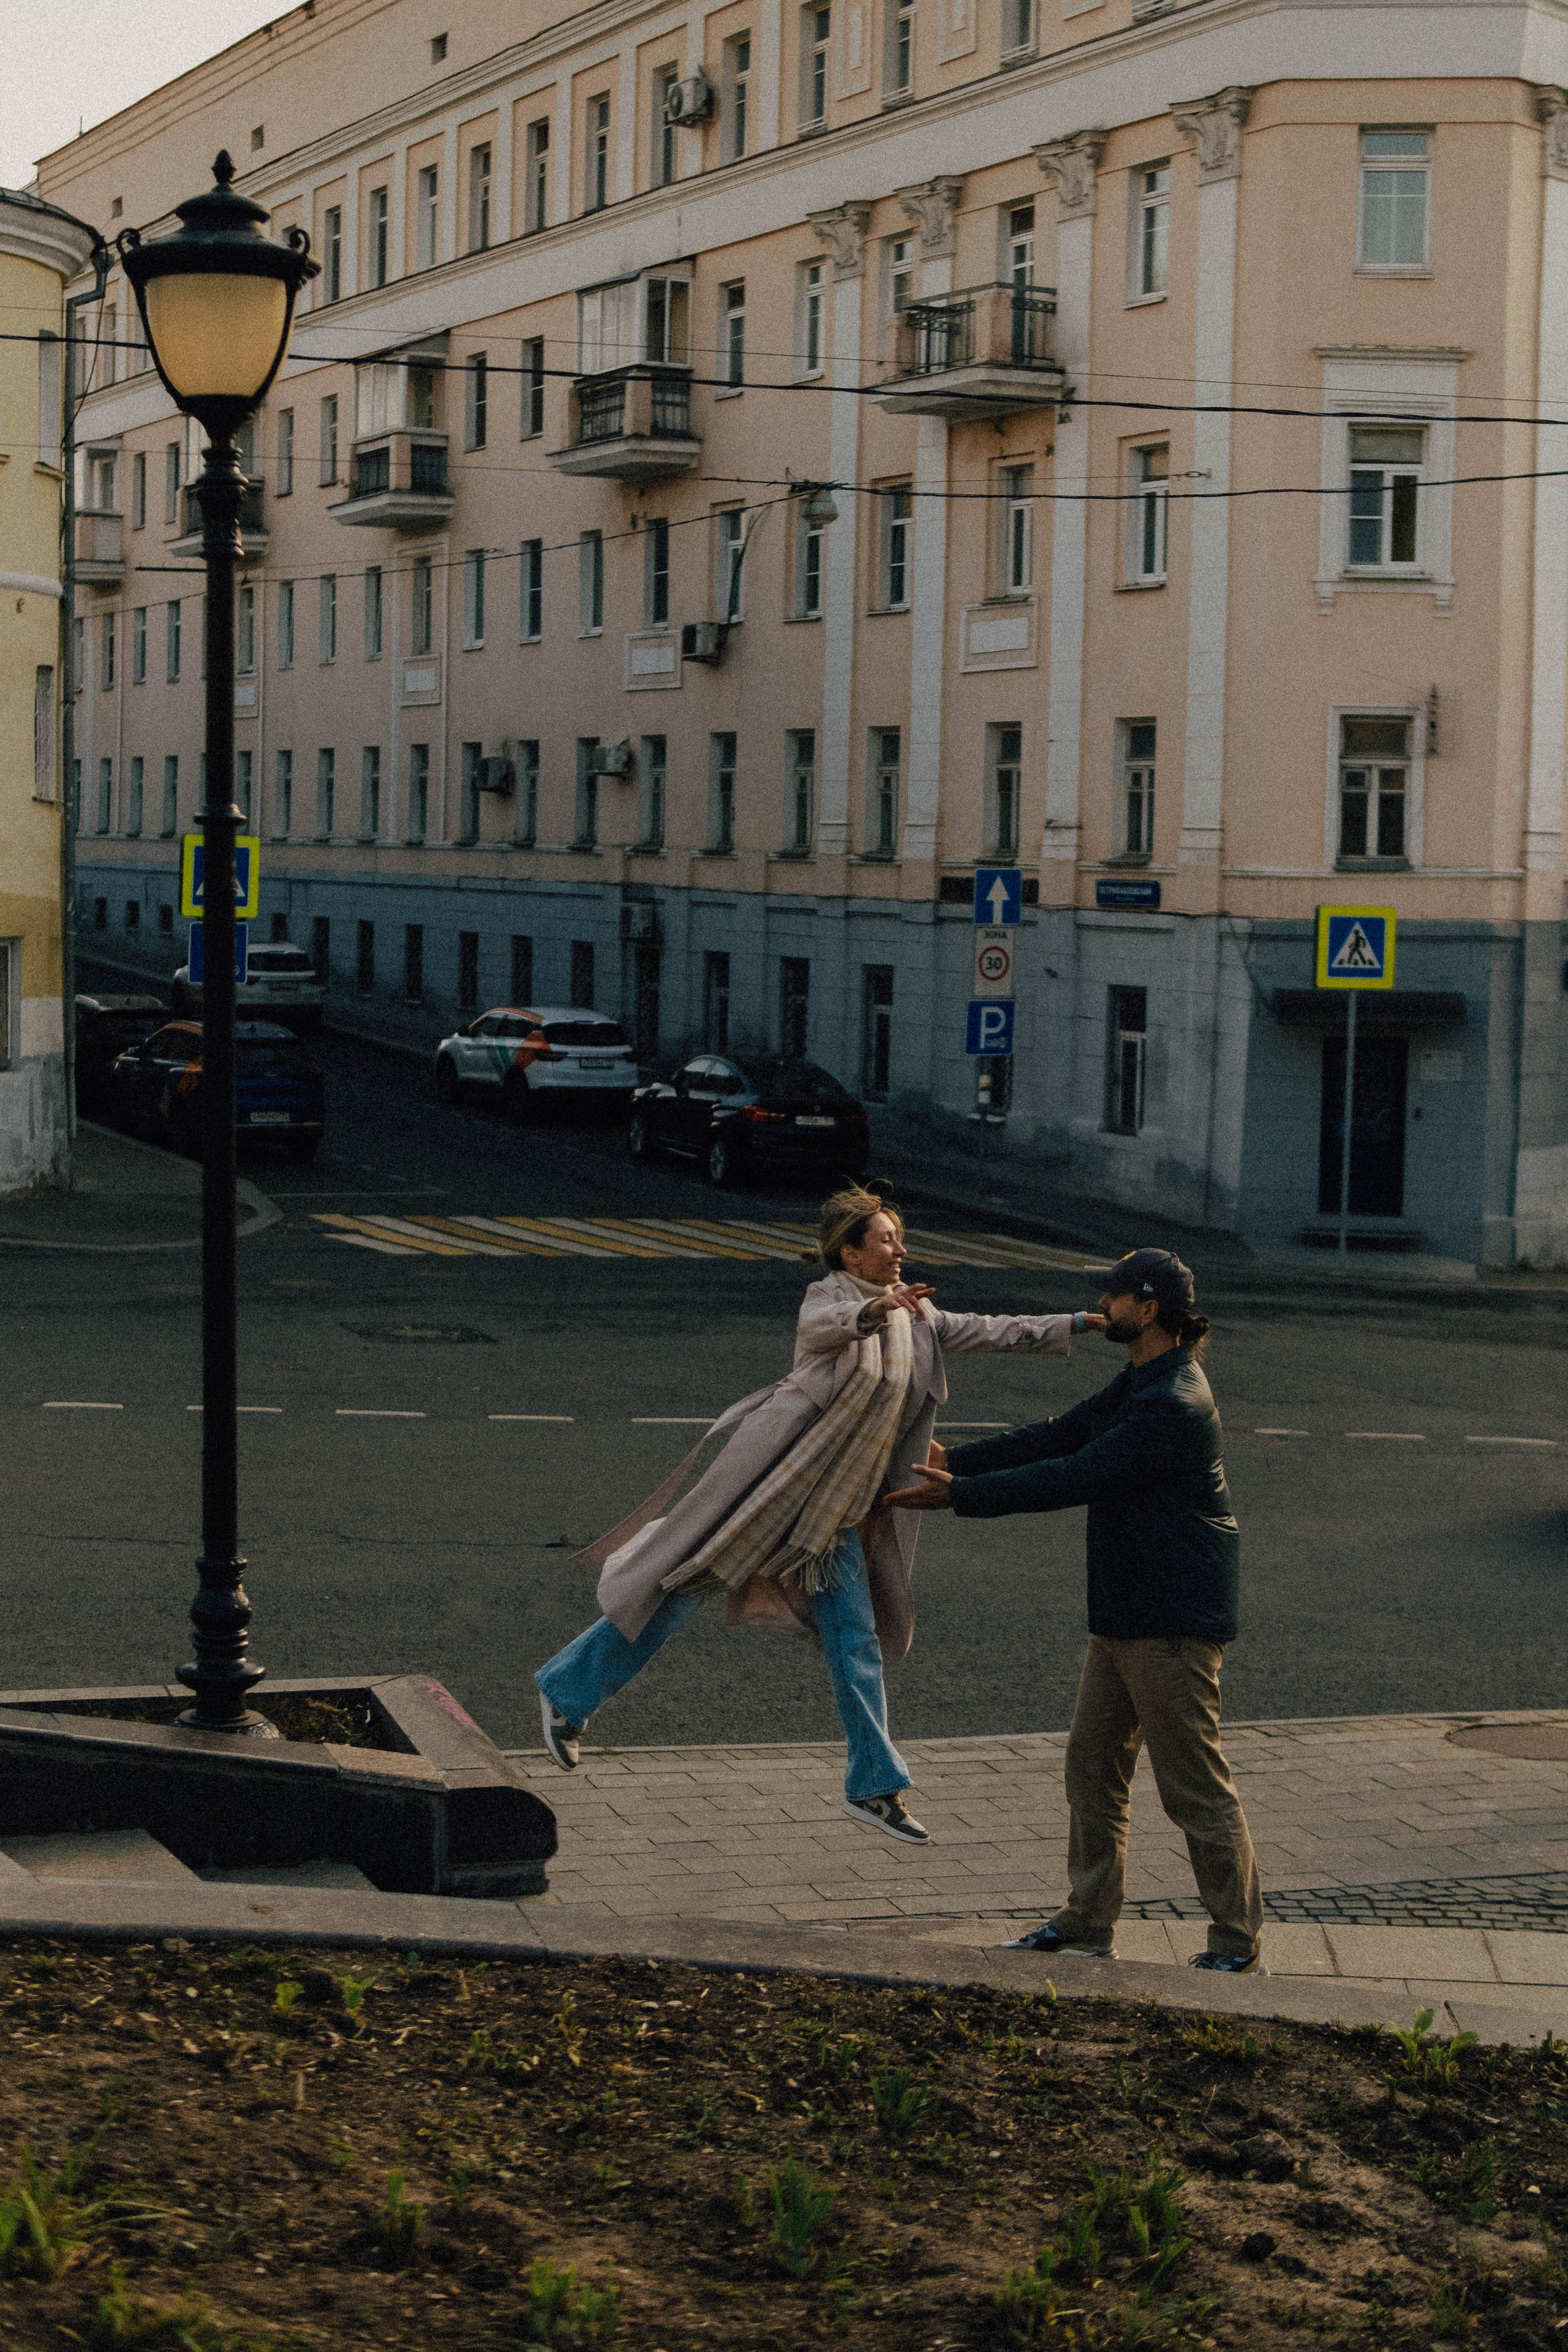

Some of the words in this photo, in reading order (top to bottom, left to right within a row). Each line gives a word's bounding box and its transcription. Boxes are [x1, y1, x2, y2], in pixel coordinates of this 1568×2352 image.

[984, 930, 1007, 939] ЗОНА
[985, 956, 1003, 970] 30
[979, 1006, 1006, 1049] P
